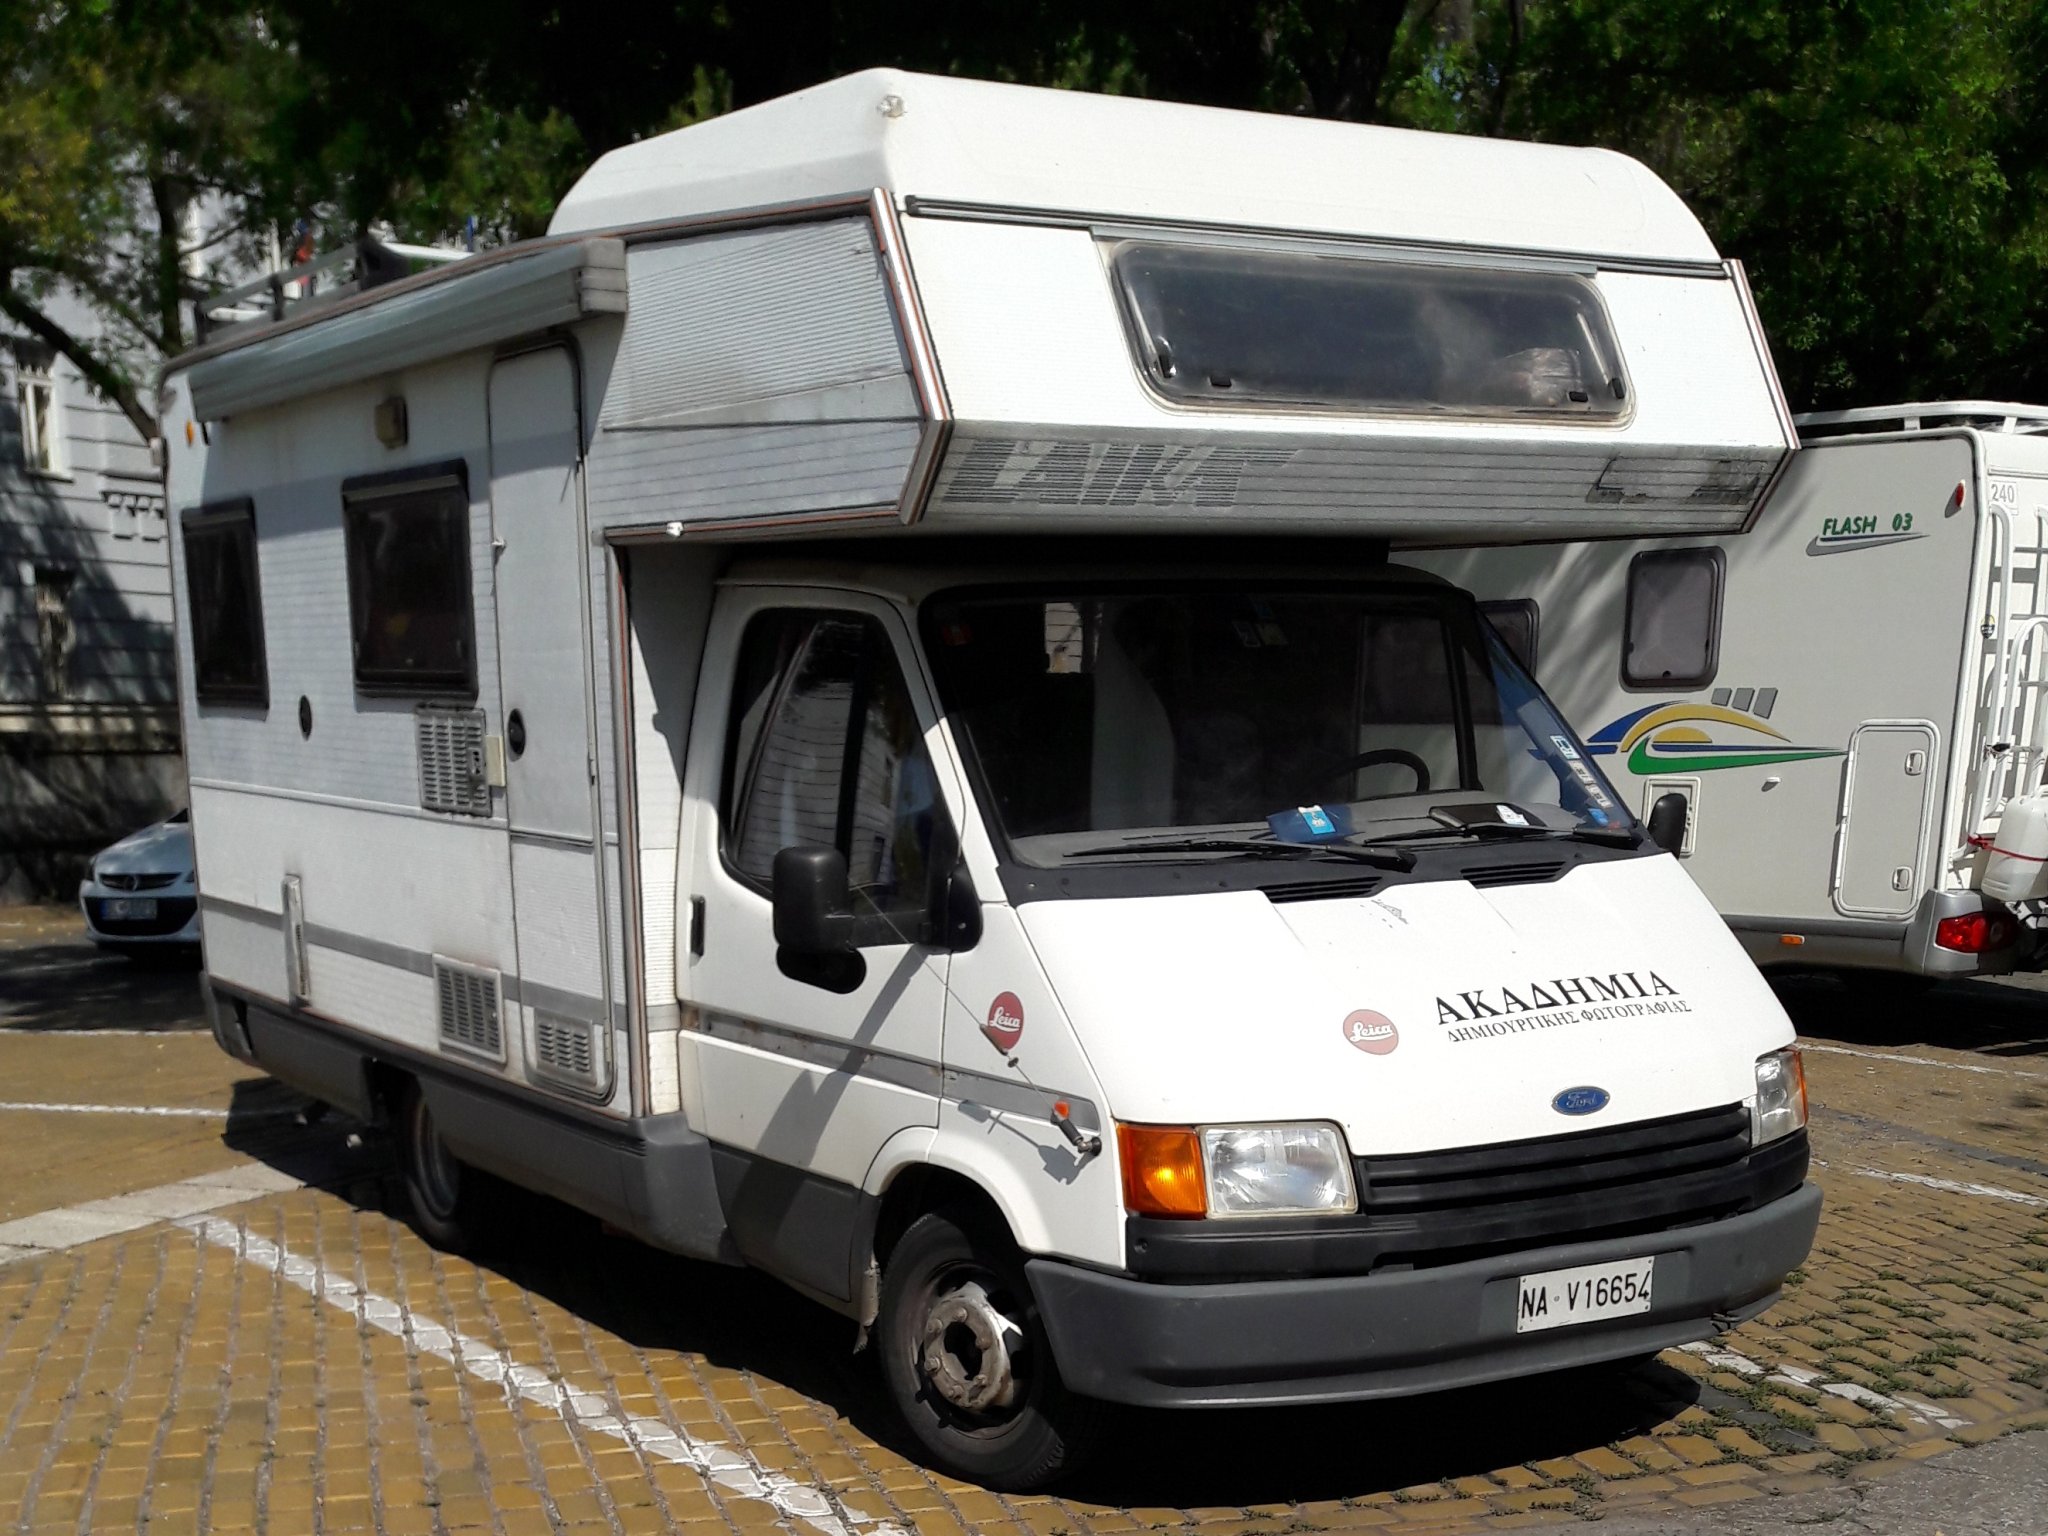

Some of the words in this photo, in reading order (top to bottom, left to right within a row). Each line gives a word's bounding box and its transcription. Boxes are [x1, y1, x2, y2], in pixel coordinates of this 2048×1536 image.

[1991, 483, 2015, 503] 240
[1822, 515, 1878, 536] FLASH
[1891, 512, 1913, 532] 03
[1436, 970, 1680, 1026] ΑΚΑΔΗΜΙΑ
[989, 1006, 1021, 1032] Leica
[1349, 1021, 1395, 1042] Leica
[1448, 1010, 1580, 1042] ΔΗΜΙΟΥΡΓΙΚΗΣ
[1581, 1000, 1692, 1022] ΦΩΤΟΓΡΑΦΙΑΣ
[1566, 1091, 1597, 1109] Ford
[1521, 1286, 1548, 1319] NA
[1568, 1270, 1651, 1312] V16654
